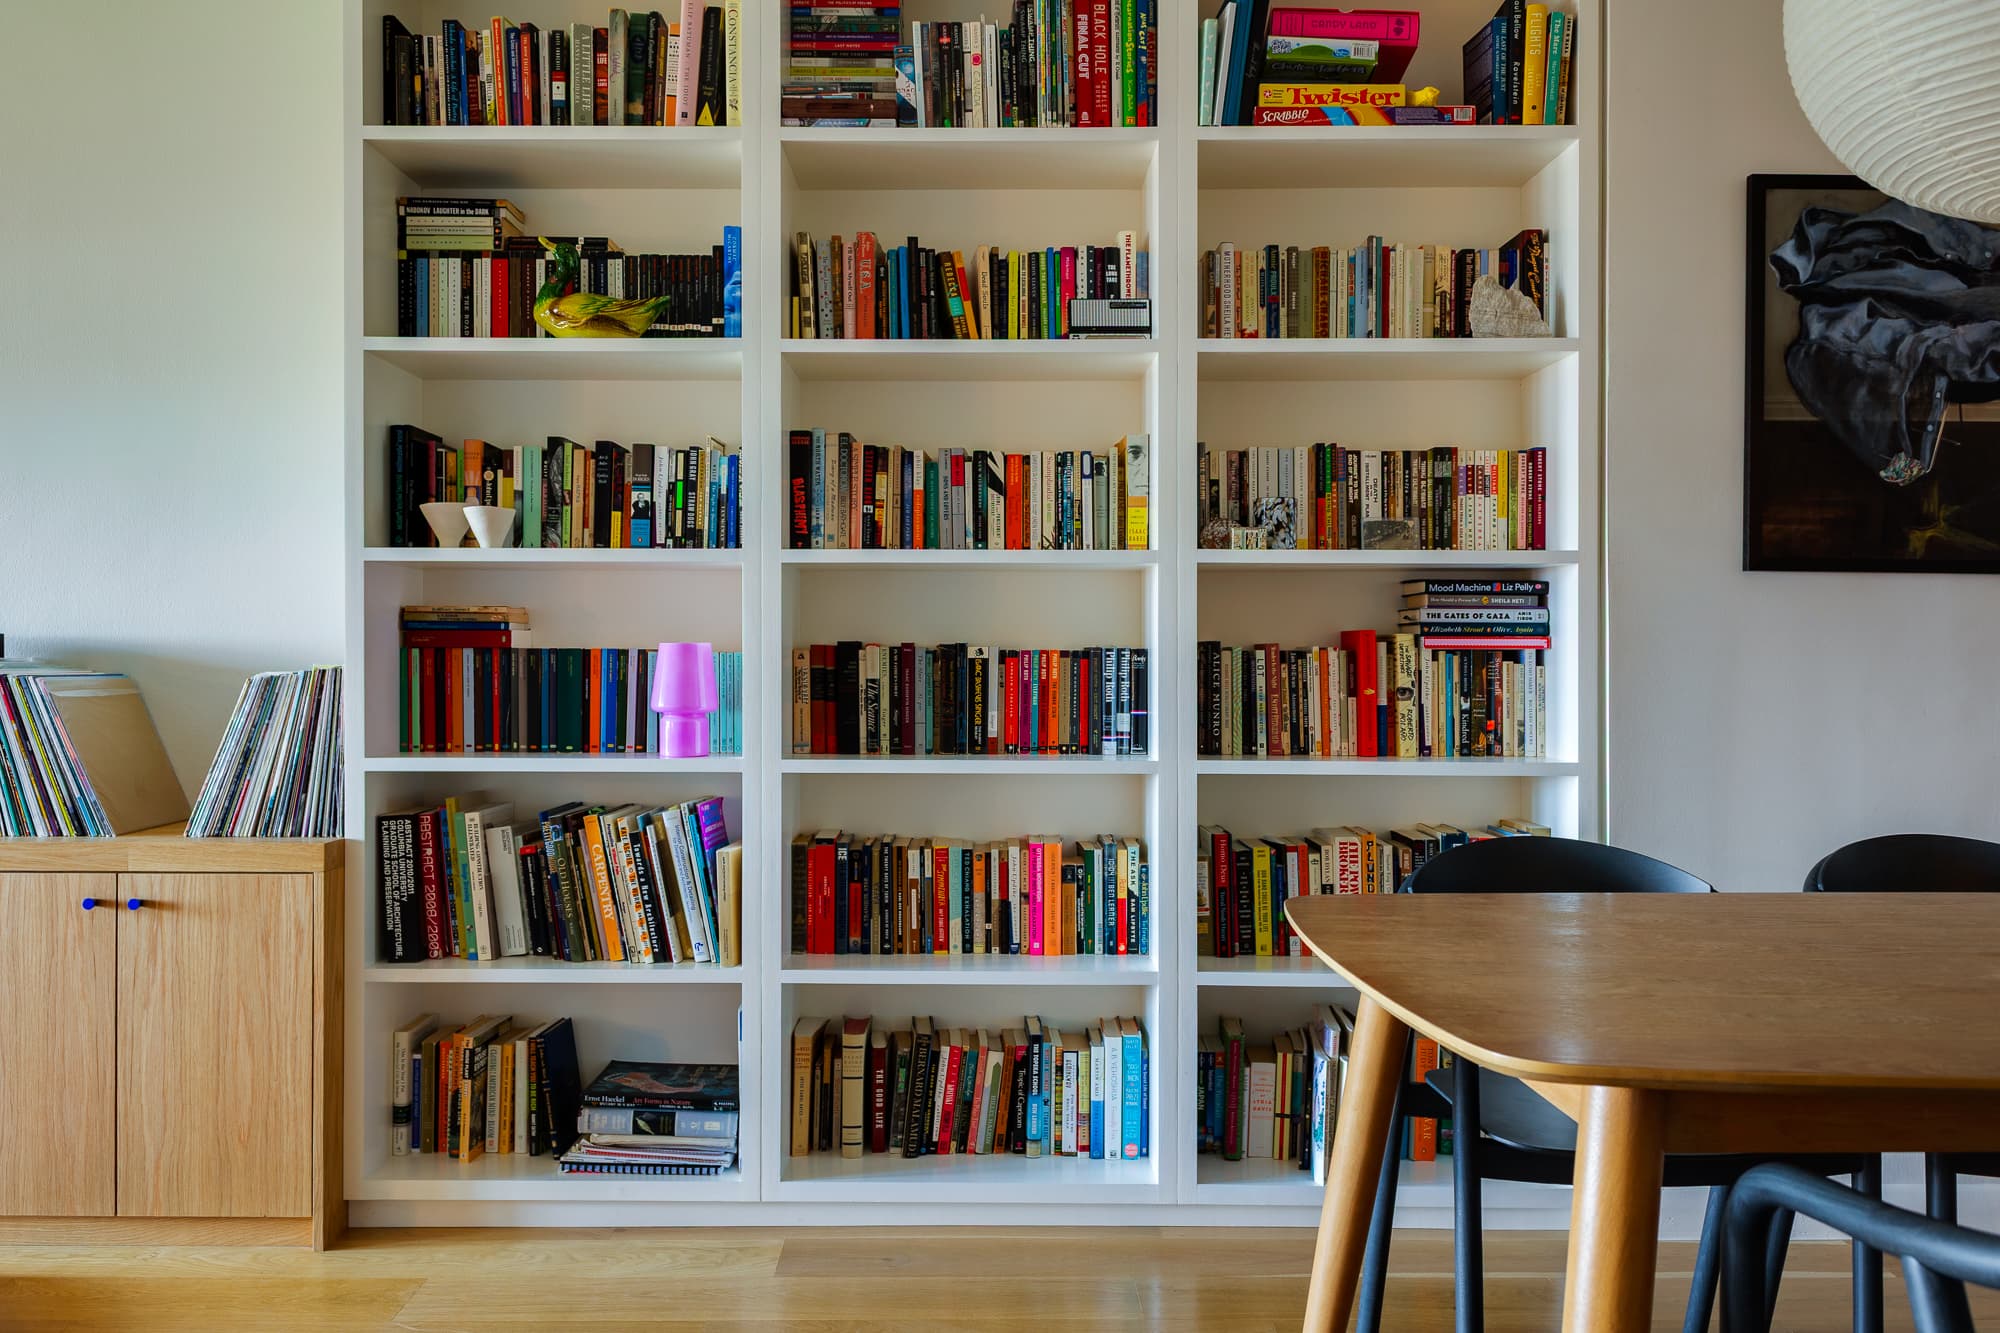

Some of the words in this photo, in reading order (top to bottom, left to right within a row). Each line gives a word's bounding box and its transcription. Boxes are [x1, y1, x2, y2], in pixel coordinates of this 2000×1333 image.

[1027, 8, 1035, 37] SWAMP
[1077, 14, 1089, 51] FINAL
[1093, 4, 1106, 39] BLACK
[1311, 20, 1345, 29] CANDY
[1351, 20, 1376, 29] LAND
[1530, 13, 1543, 55] FLIGHTS
[729, 9, 740, 84] CONSTANCIA
[1094, 45, 1107, 75] HOLE
[1552, 35, 1561, 55] Mare
[583, 44, 592, 83] LITTLE
[1078, 54, 1089, 79] CUT
[1287, 87, 1400, 106] Twister
[1512, 62, 1520, 105] Ravelstein
[583, 88, 591, 111] LIFE
[1262, 109, 1308, 123] SCRABBLE
[943, 263, 957, 296] REBECCA
[688, 492, 696, 511] STRAW
[791, 477, 808, 534] BLASPHEMY
[1429, 584, 1453, 592] Mood
[1456, 583, 1490, 591] Machine
[1502, 583, 1513, 591] Liz
[1515, 583, 1533, 592] Pelly
[1430, 625, 1461, 633] Elizabeth
[1105, 652, 1115, 679] Philip
[1120, 651, 1130, 679] Philip
[1106, 682, 1115, 702] Roth
[1121, 681, 1129, 701] Roth
[1462, 713, 1470, 743] Kindred
[381, 821, 390, 858] PLANNING
[389, 820, 398, 858] GRADUATE
[397, 820, 406, 857] COLUMBIA
[404, 819, 413, 857] ABSTRACT
[420, 815, 434, 879] ABSTRACT
[675, 825, 685, 845] Interior
[557, 857, 567, 877] OLD
[678, 846, 691, 879] Construction
[838, 848, 847, 861] ICE
[1339, 841, 1348, 893] BROKER
[399, 858, 407, 901] UNIVERSITY
[406, 859, 414, 894] 2010/2011
[591, 844, 614, 920] CARPENTRY
[385, 877, 394, 930] PRESERVATION
[393, 890, 399, 899] OF
[560, 881, 573, 918] HOUSES
[686, 886, 697, 911] Detailing
[645, 904, 659, 952] Architecture
[876, 1069, 884, 1083] THE
[915, 1047, 926, 1096] BERNARD
[1017, 1068, 1026, 1088] Tropic
[602, 1095, 625, 1104] Haeckel
[875, 1088, 884, 1108] GOOD
[1015, 1097, 1025, 1128] Capricorn
[488, 1121, 496, 1138] BLOOM
[875, 1112, 883, 1128] LIFE
[907, 1098, 920, 1152] MALAMUD
